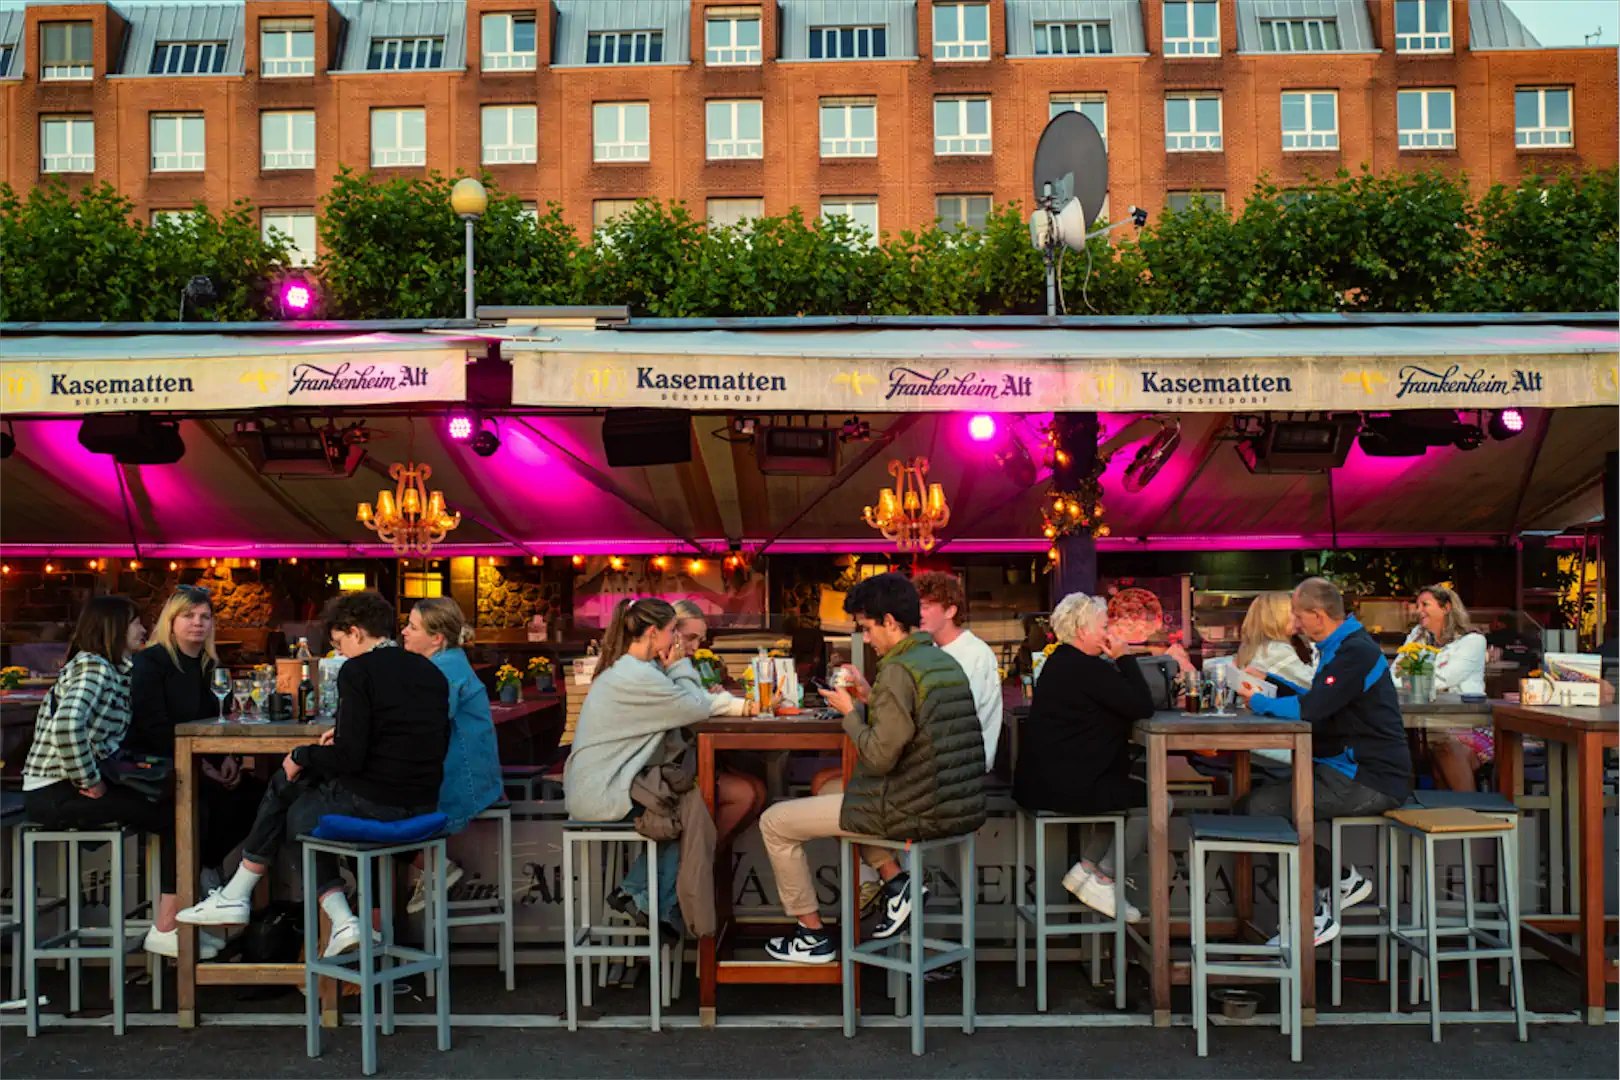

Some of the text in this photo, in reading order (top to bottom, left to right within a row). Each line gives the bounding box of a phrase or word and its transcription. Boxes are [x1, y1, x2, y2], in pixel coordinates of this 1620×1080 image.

[50, 374, 194, 395] Kasematten
[288, 362, 428, 395] Frankenheim Alt
[636, 367, 786, 391] Kasematten
[885, 367, 1032, 400] Frankenheim Alt
[1141, 371, 1292, 392] Kasematten
[1395, 364, 1542, 398] Frankenheim Alt
